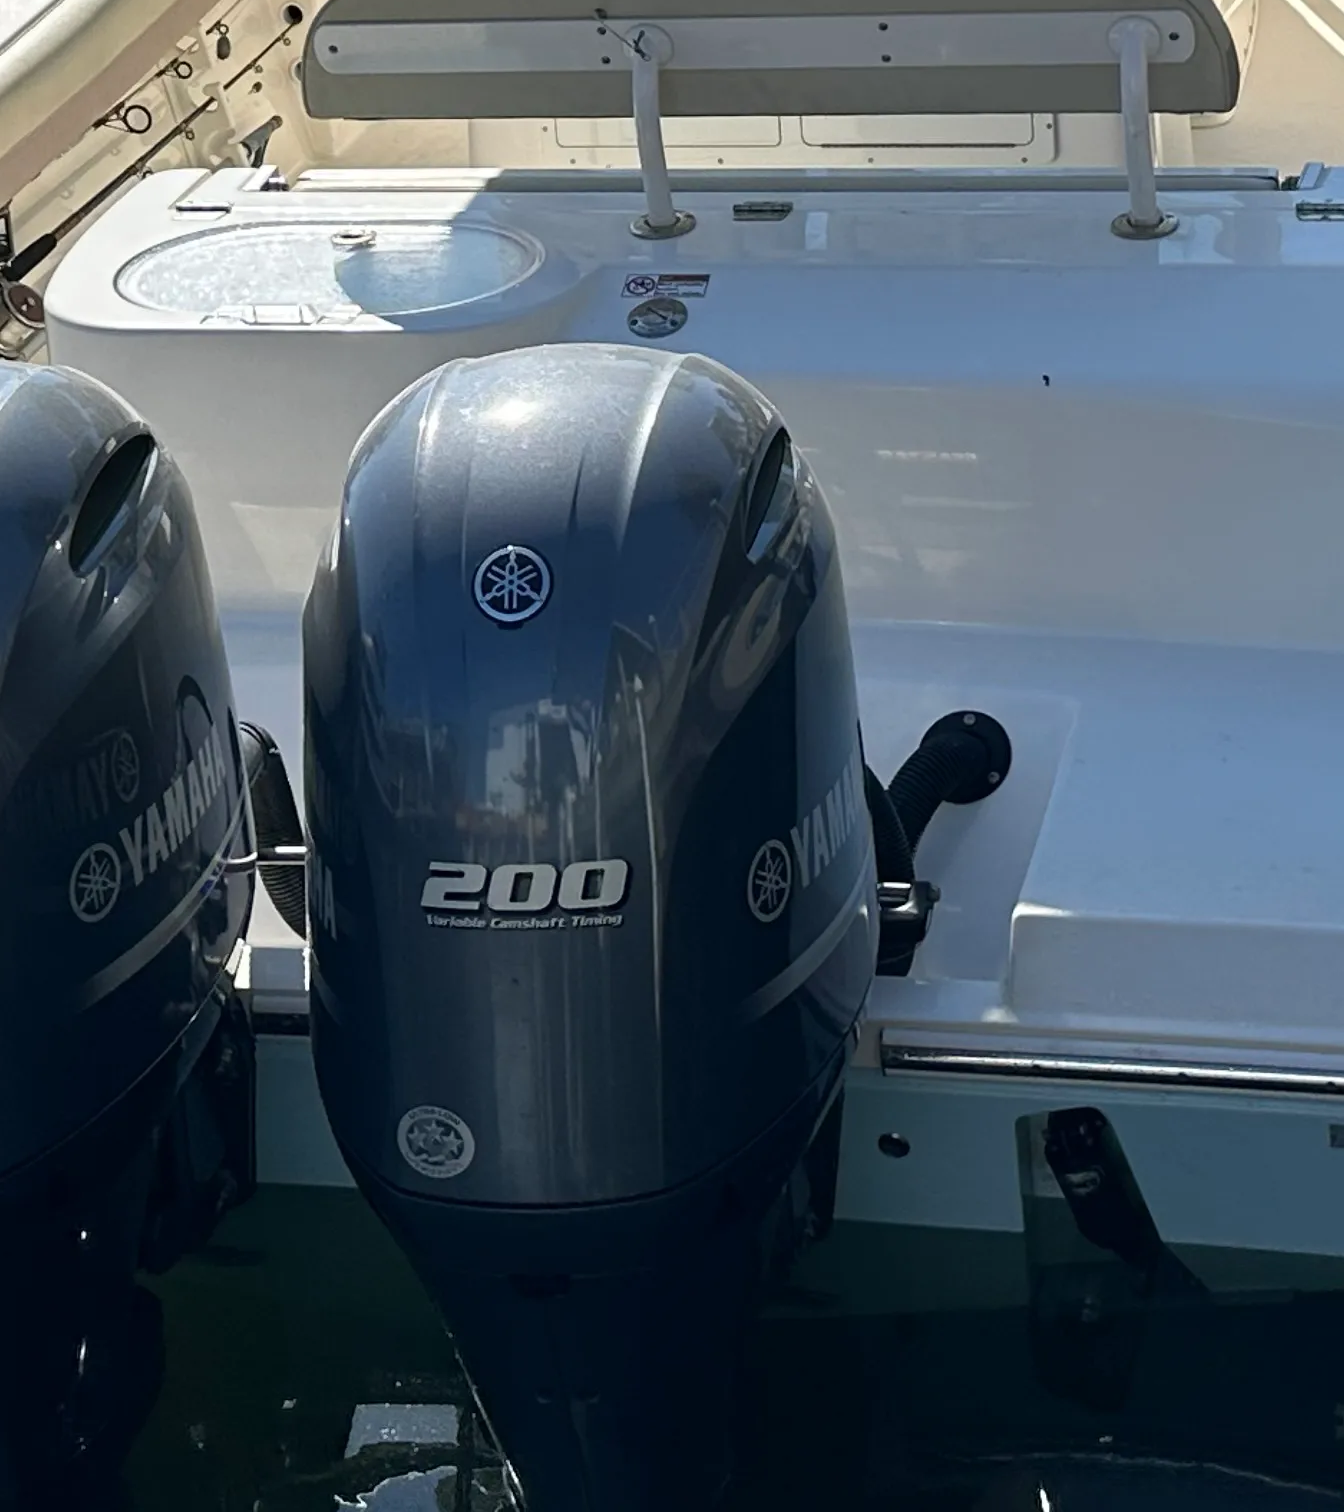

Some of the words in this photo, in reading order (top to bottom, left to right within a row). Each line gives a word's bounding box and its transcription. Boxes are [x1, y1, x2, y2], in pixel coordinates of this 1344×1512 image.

[118, 722, 227, 887] YAMAHA
[420, 858, 629, 912] 200
[427, 914, 486, 929] Variable
[490, 914, 566, 929] Camshaft
[571, 913, 624, 928] Timing
